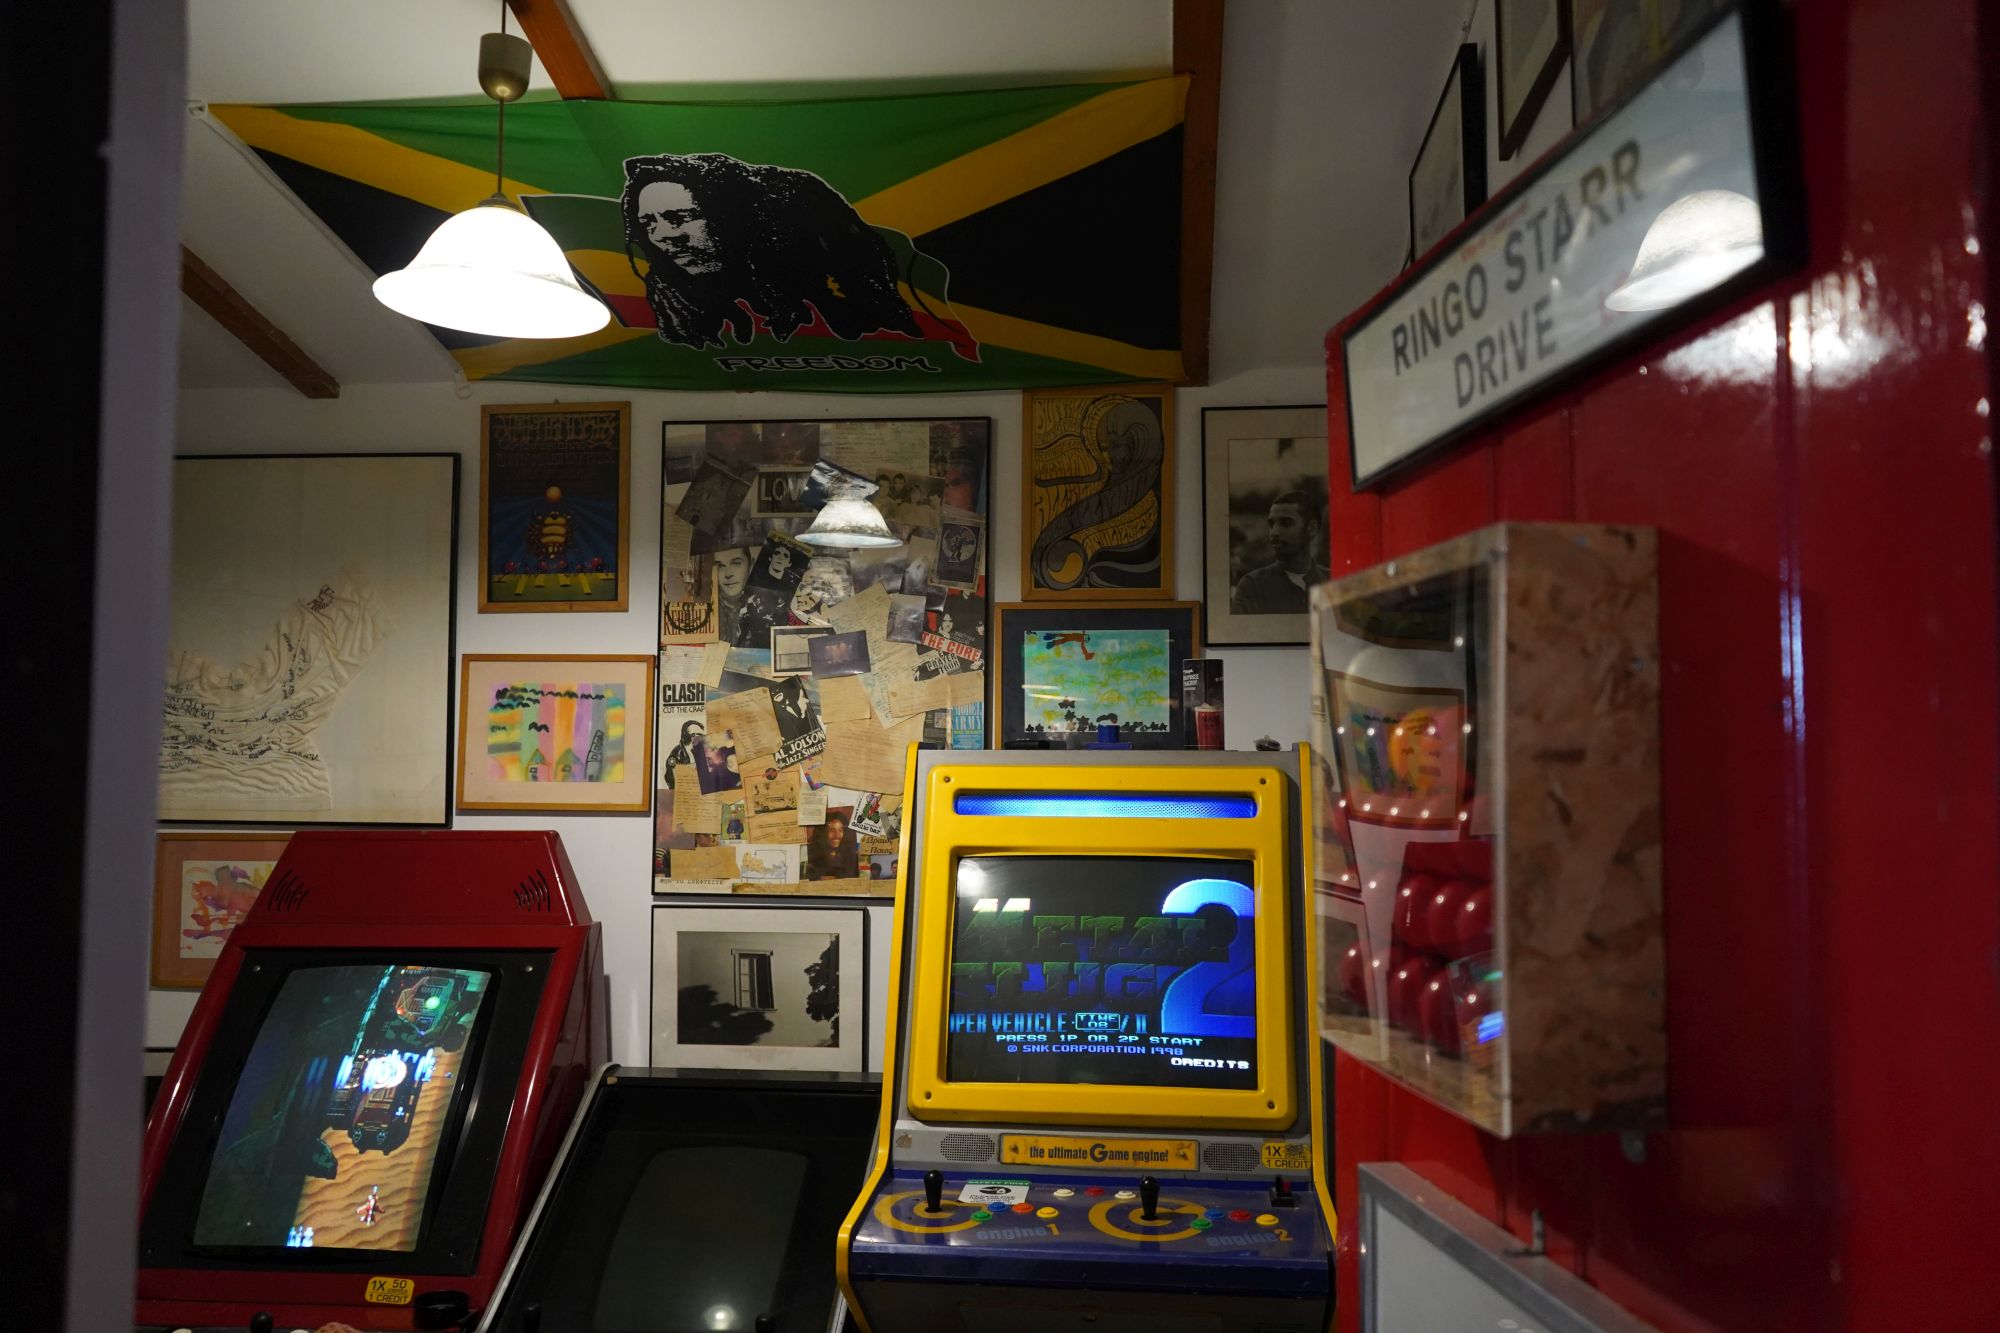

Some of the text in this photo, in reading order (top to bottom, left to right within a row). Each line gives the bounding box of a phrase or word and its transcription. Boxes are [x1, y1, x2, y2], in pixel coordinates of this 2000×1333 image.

[1391, 262, 1487, 376] RINGO
[1504, 139, 1643, 294] STARR
[1454, 298, 1557, 409] DRIVE
[713, 355, 942, 373] FREEDOM
[921, 632, 945, 651] THE
[946, 641, 982, 662] CURE
[926, 653, 958, 671] PRAYER
[939, 660, 960, 675] TOUR
[662, 683, 705, 703] CLASH
[775, 749, 788, 762] AL
[789, 731, 826, 755] JOLSON
[785, 750, 804, 766] JAZZ
[1161, 878, 1255, 1039] 2
[991, 1012, 1068, 1034] VEHICLE
[1078, 1013, 1118, 1022] TIME
[1087, 1021, 1109, 1030] 08
[996, 1034, 1204, 1046] PRESS 1P OR 2P START
[1022, 1044, 1049, 1053] SNK
[1052, 1044, 1146, 1055] CORPORATION
[1151, 1047, 1184, 1056] 1998
[1029, 1143, 1169, 1163] the ultimate Game engine!
[1265, 1145, 1281, 1157] 1X
[1275, 1160, 1308, 1169] CREDIT
[370, 1279, 407, 1291] 1X 50
[376, 1293, 408, 1304] CREDIT
